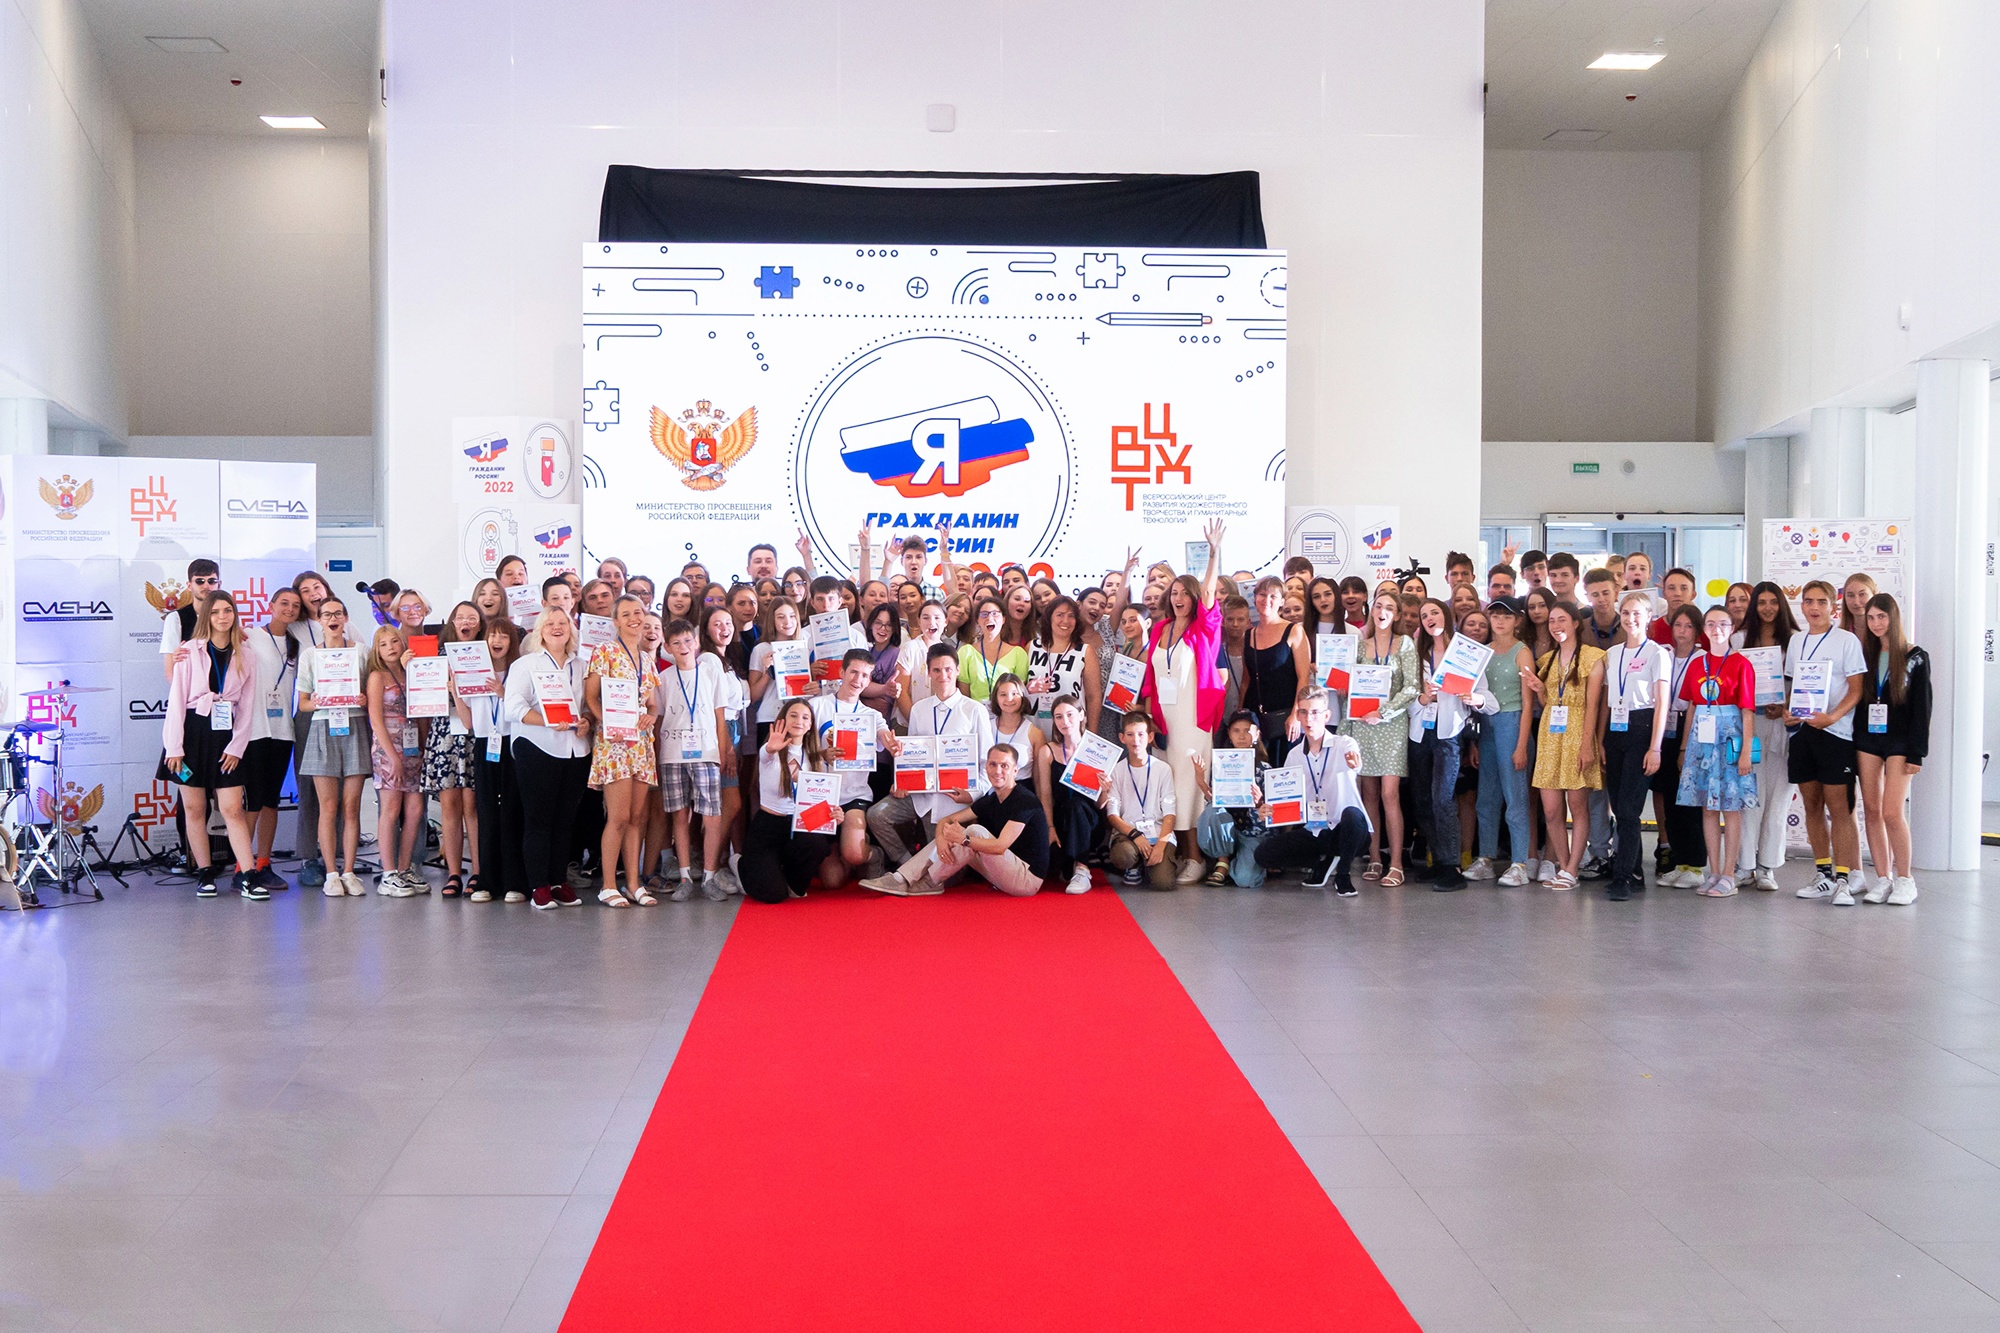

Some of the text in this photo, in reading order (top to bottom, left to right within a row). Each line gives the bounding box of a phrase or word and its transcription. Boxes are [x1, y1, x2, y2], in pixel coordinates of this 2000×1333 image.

[909, 418, 961, 485] Я
[484, 481, 514, 493] 2022
[636, 503, 772, 512] МИНИСТЕРСТВО ПРОСВЕЩЕНИЯ
[648, 512, 760, 521] РОССИЙСКОЙ ФЕДЕРАЦИИ
[865, 512, 1020, 530] ГРАЖДАНИН
[512, 598, 536, 607] ДИПЛОМ
[819, 624, 841, 633] ДИПЛОМ
[1273, 780, 1297, 788] ДИПЛОМ
[806, 786, 831, 794] ДИПЛОМ
